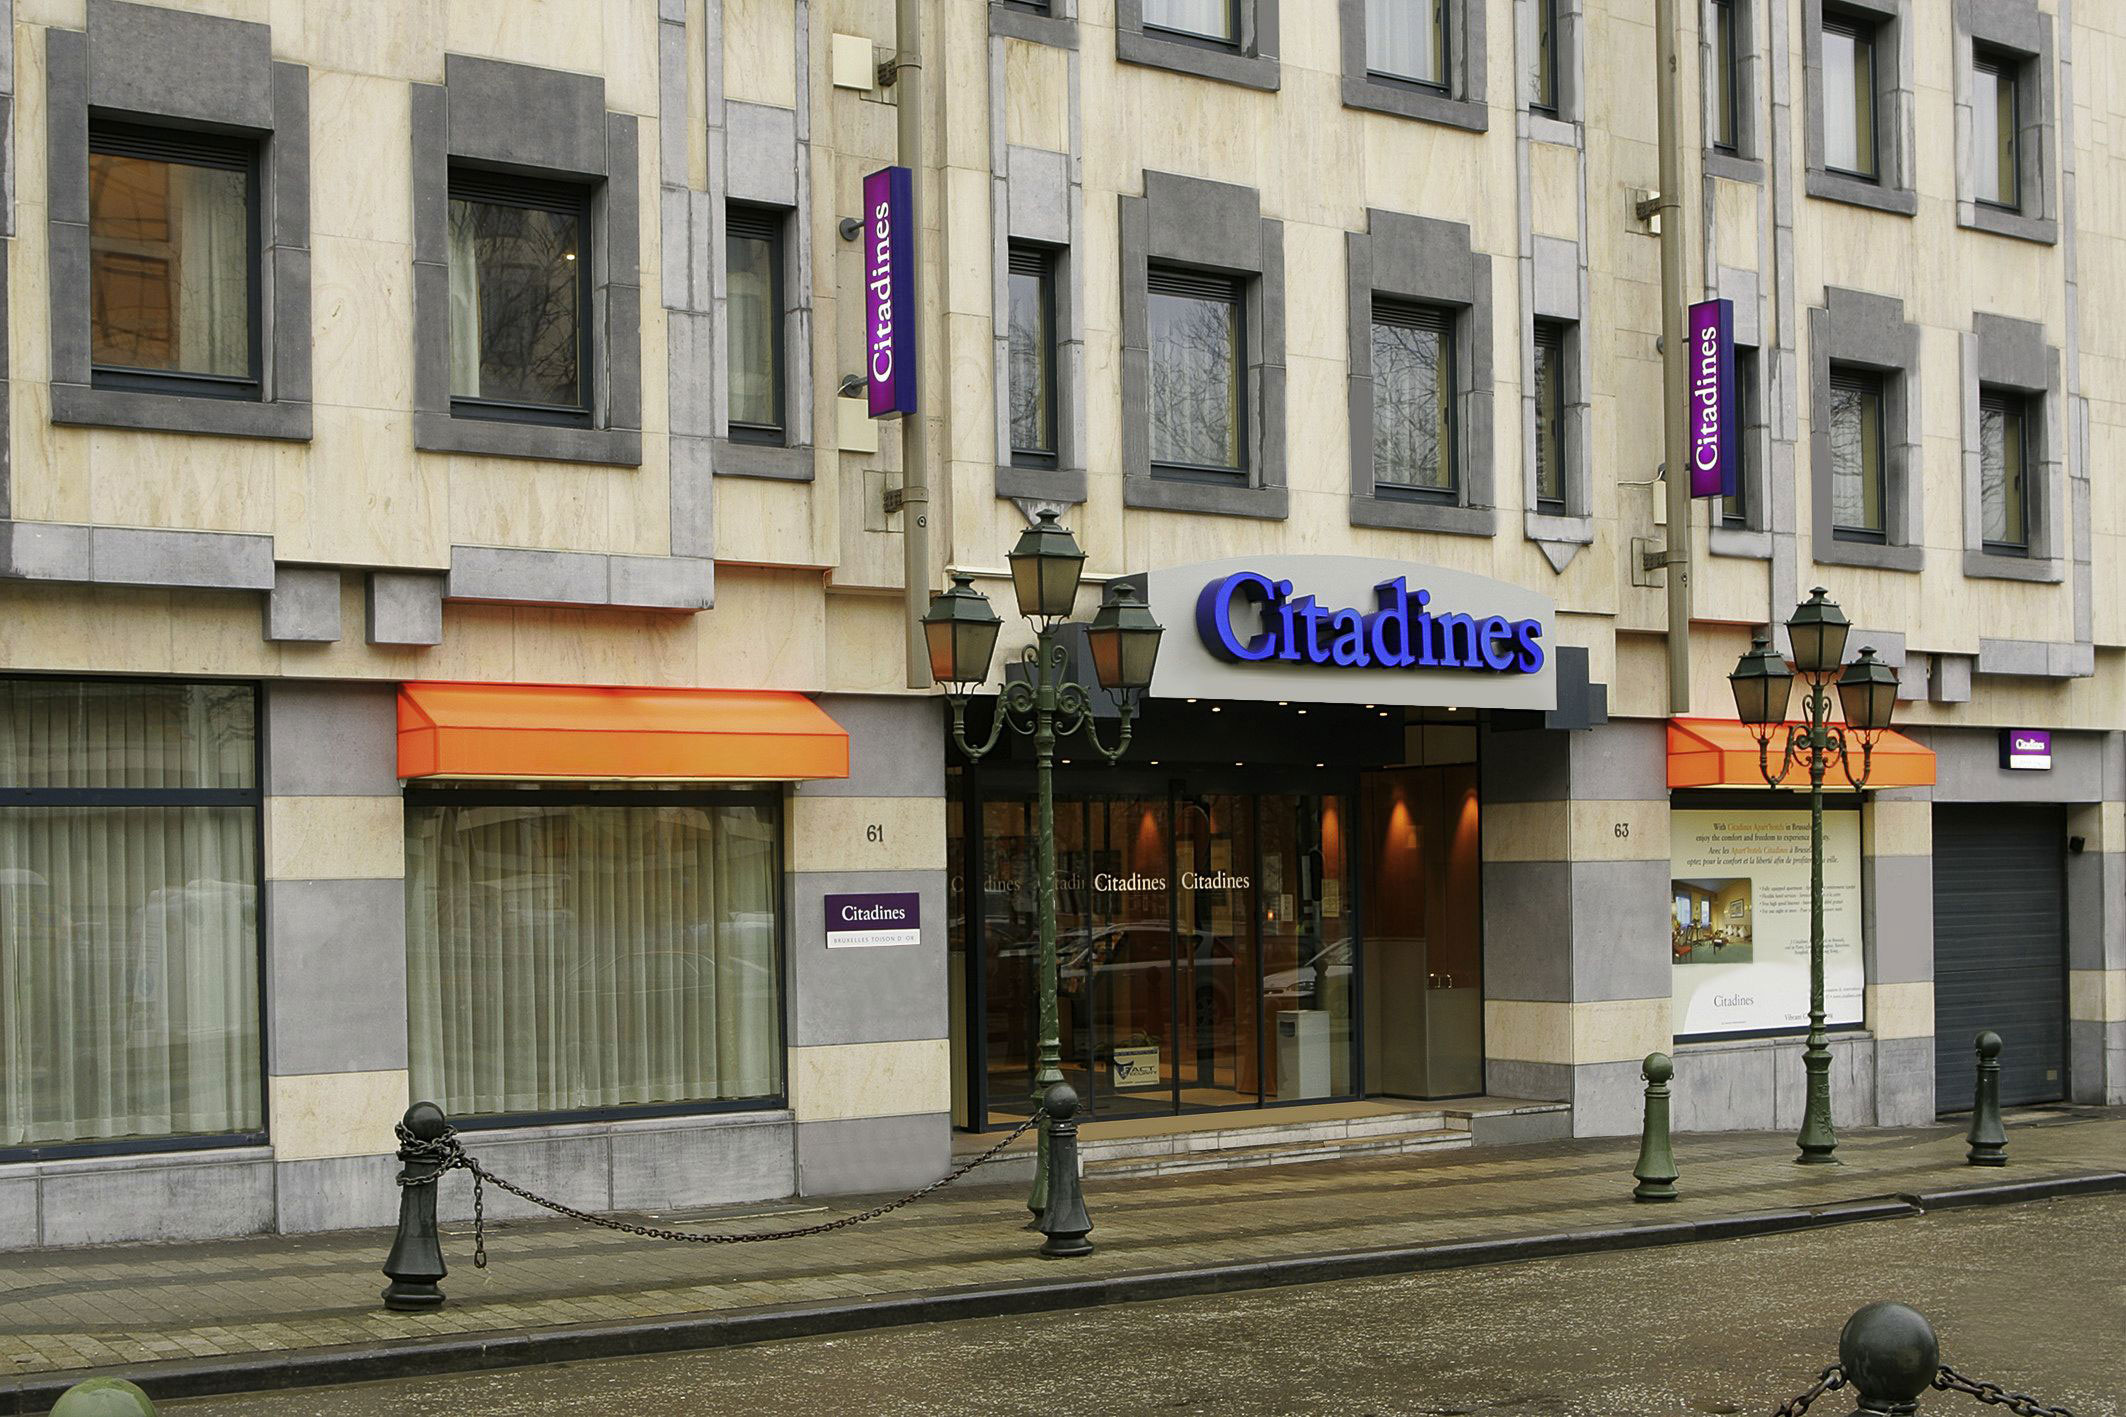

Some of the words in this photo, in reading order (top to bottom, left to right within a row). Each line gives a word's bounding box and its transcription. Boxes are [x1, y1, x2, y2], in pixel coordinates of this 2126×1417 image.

[870, 201, 893, 383] Citadines
[1695, 326, 1718, 471] Citadines
[1196, 571, 1545, 675] Citadines
[866, 824, 884, 842] 61
[1614, 823, 1629, 838] 63
[1094, 873, 1166, 891] Citadines
[1181, 871, 1250, 890] Citadines
[841, 904, 906, 921] Citadines
[1713, 993, 1754, 1007] Citadines
